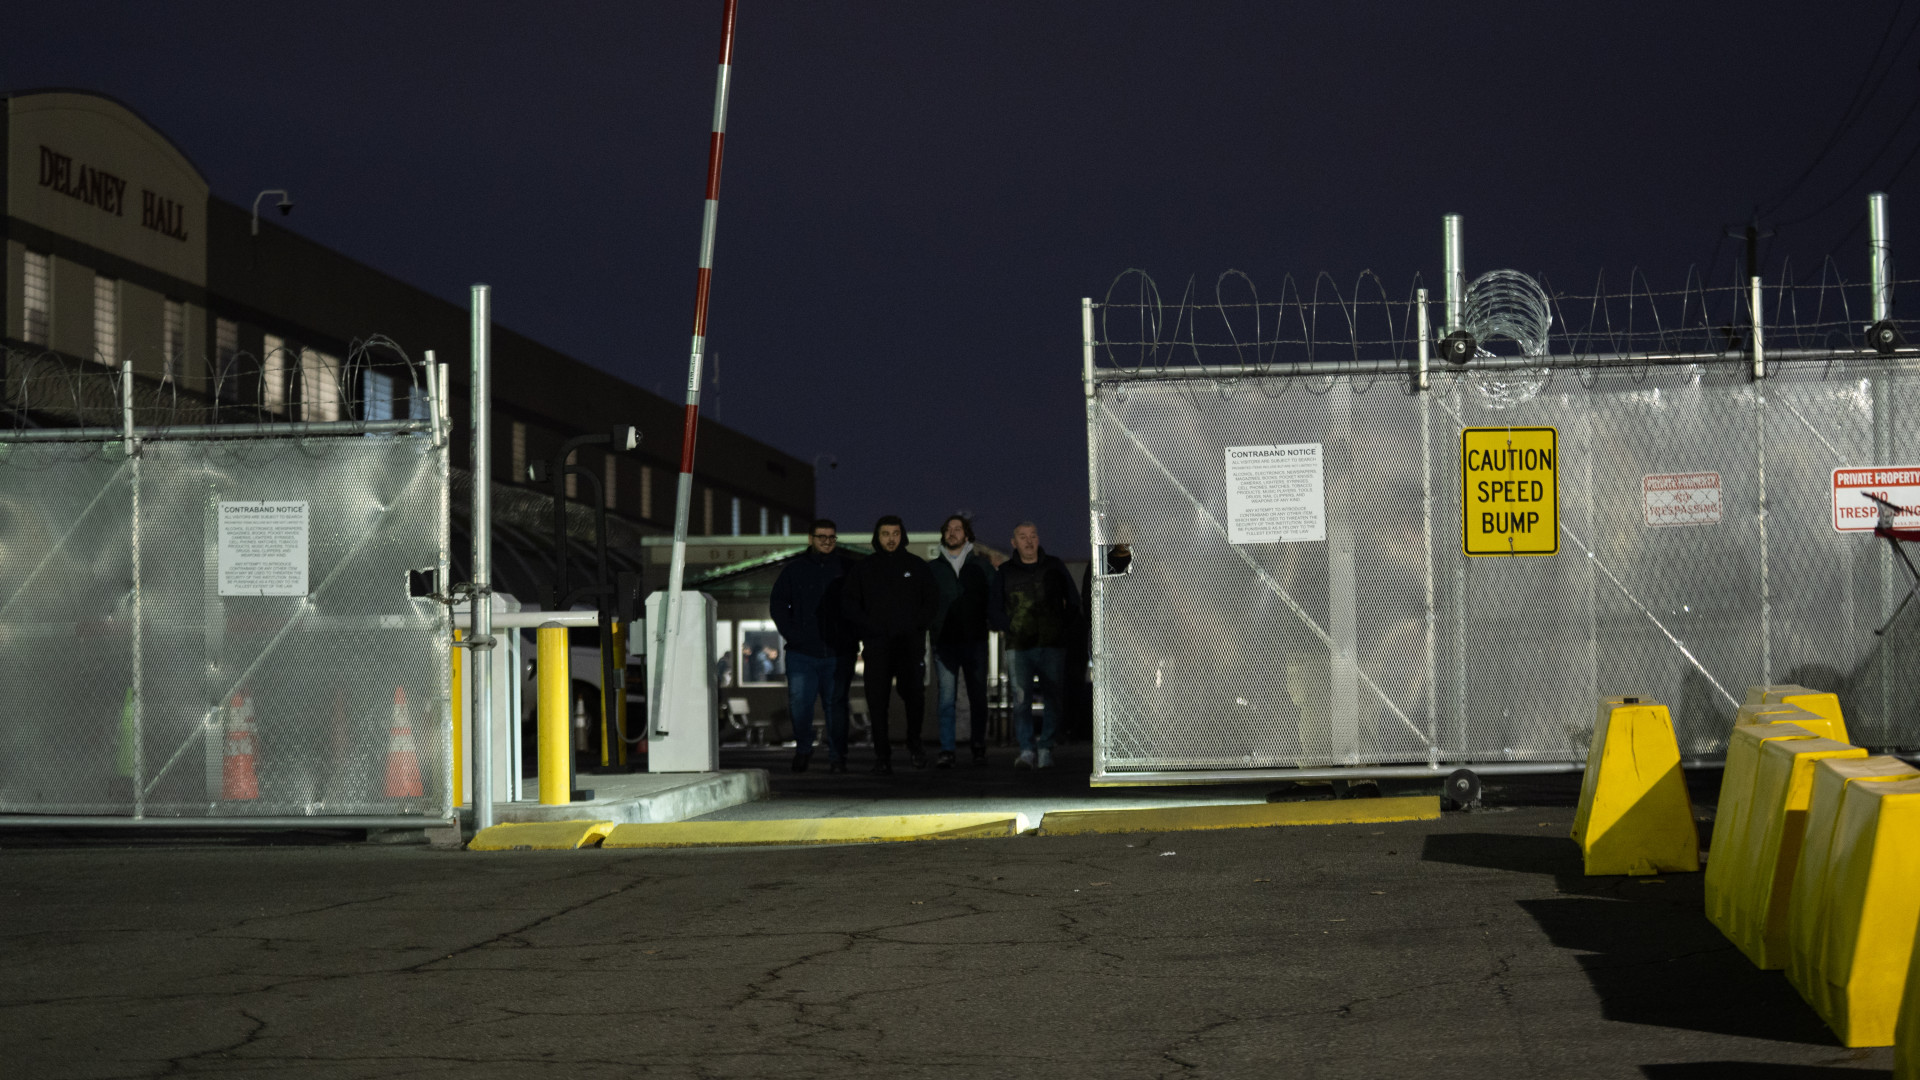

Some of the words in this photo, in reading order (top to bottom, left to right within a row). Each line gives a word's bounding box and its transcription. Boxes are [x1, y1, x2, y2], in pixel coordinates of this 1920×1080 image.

[39, 145, 127, 216] DELANEY
[141, 189, 188, 242] HALL
[1468, 449, 1552, 471] CAUTION
[1837, 472, 1873, 486] PRIVATE
[1875, 471, 1920, 485] PROPERTY
[1477, 480, 1544, 503] SPEED
[1871, 491, 1889, 503] NO
[1482, 511, 1539, 534] BUMP
